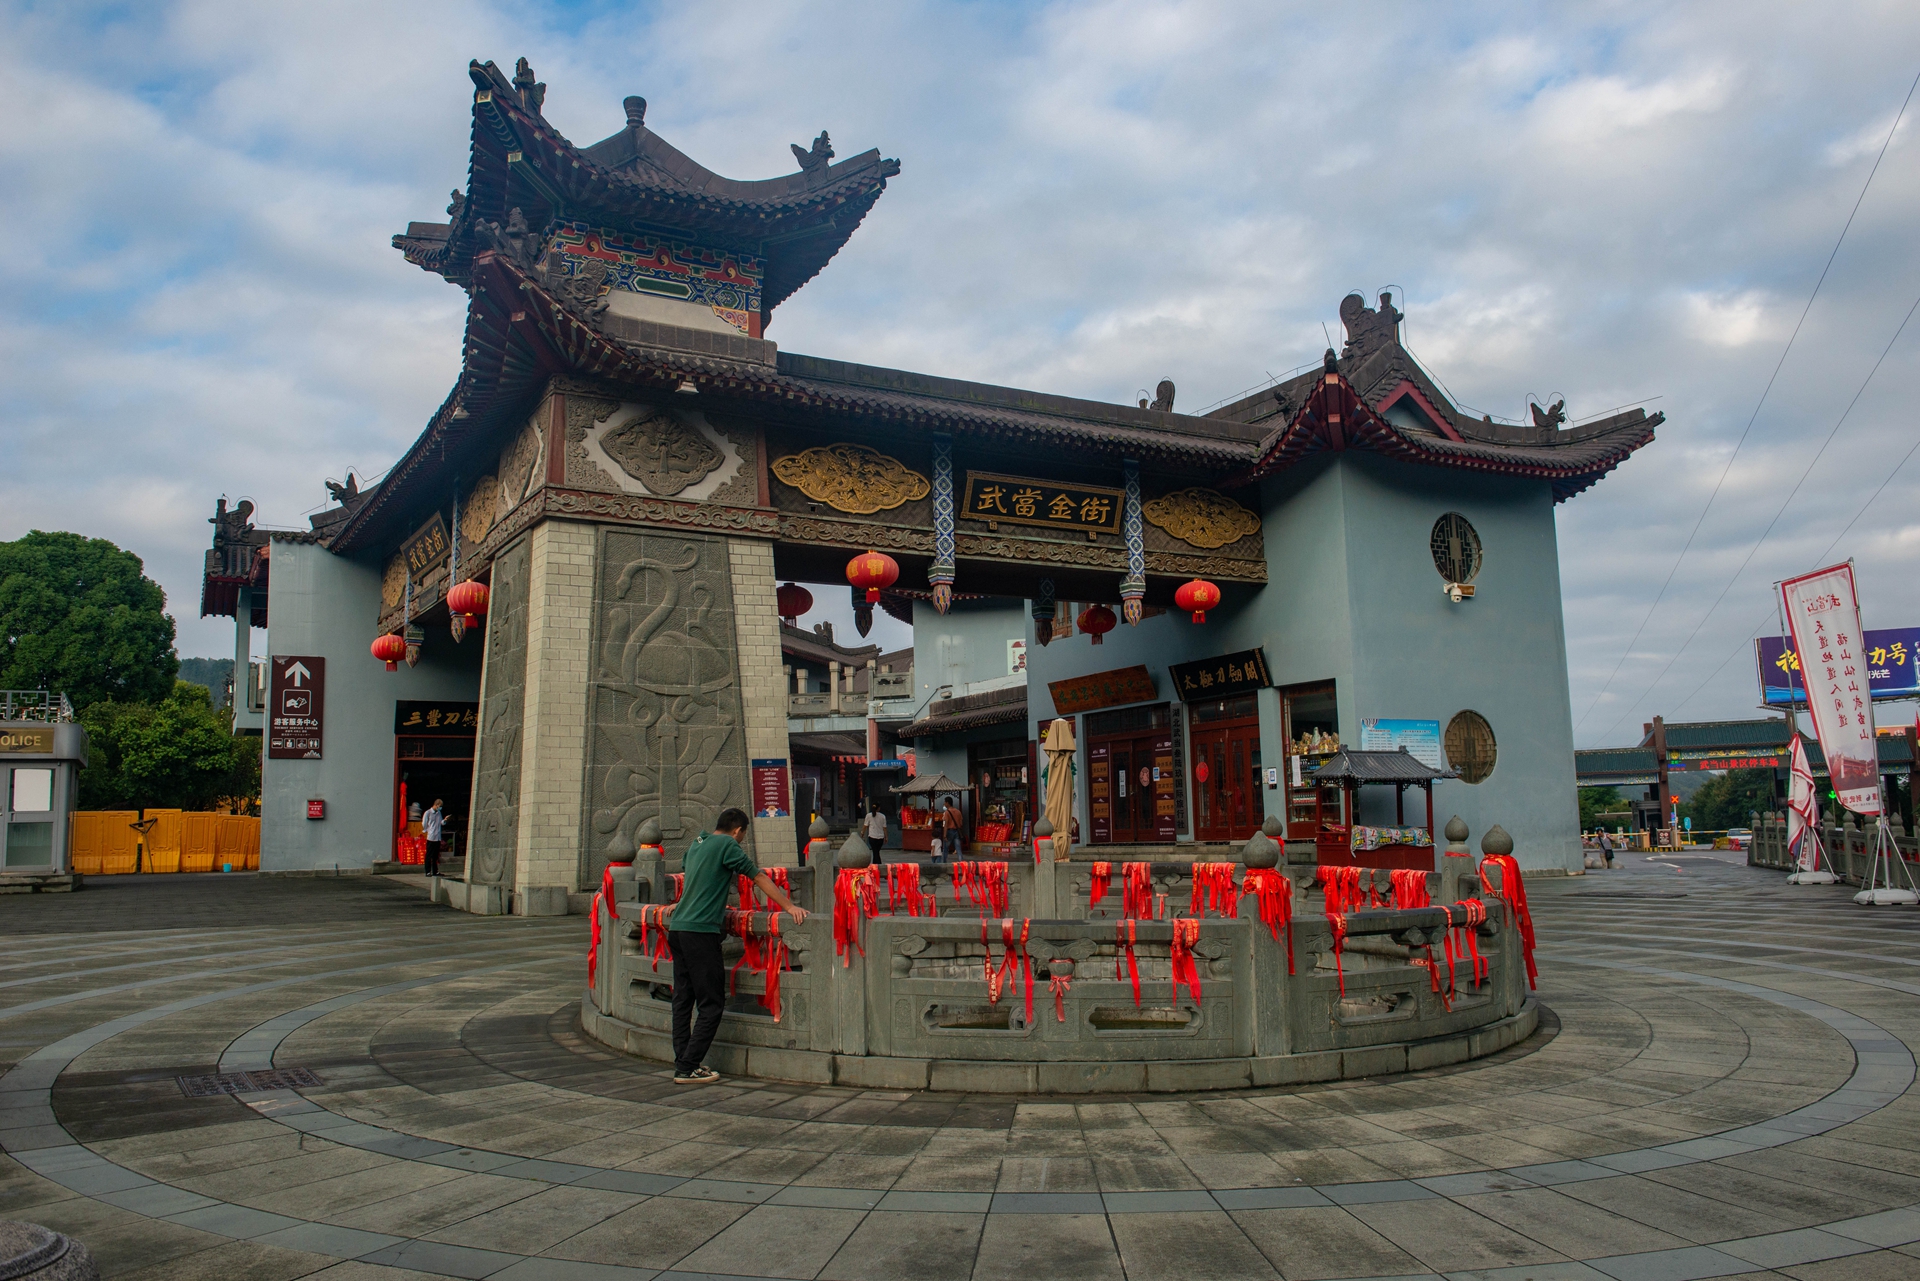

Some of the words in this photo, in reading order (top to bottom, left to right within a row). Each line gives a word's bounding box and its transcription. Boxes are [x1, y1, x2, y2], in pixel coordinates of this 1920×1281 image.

[977, 485, 1111, 524] 武當金街
[1868, 642, 1908, 666] 力号
[273, 717, 319, 727] 游客服务中心
[1699, 757, 1779, 770] 武当山景区停车场
